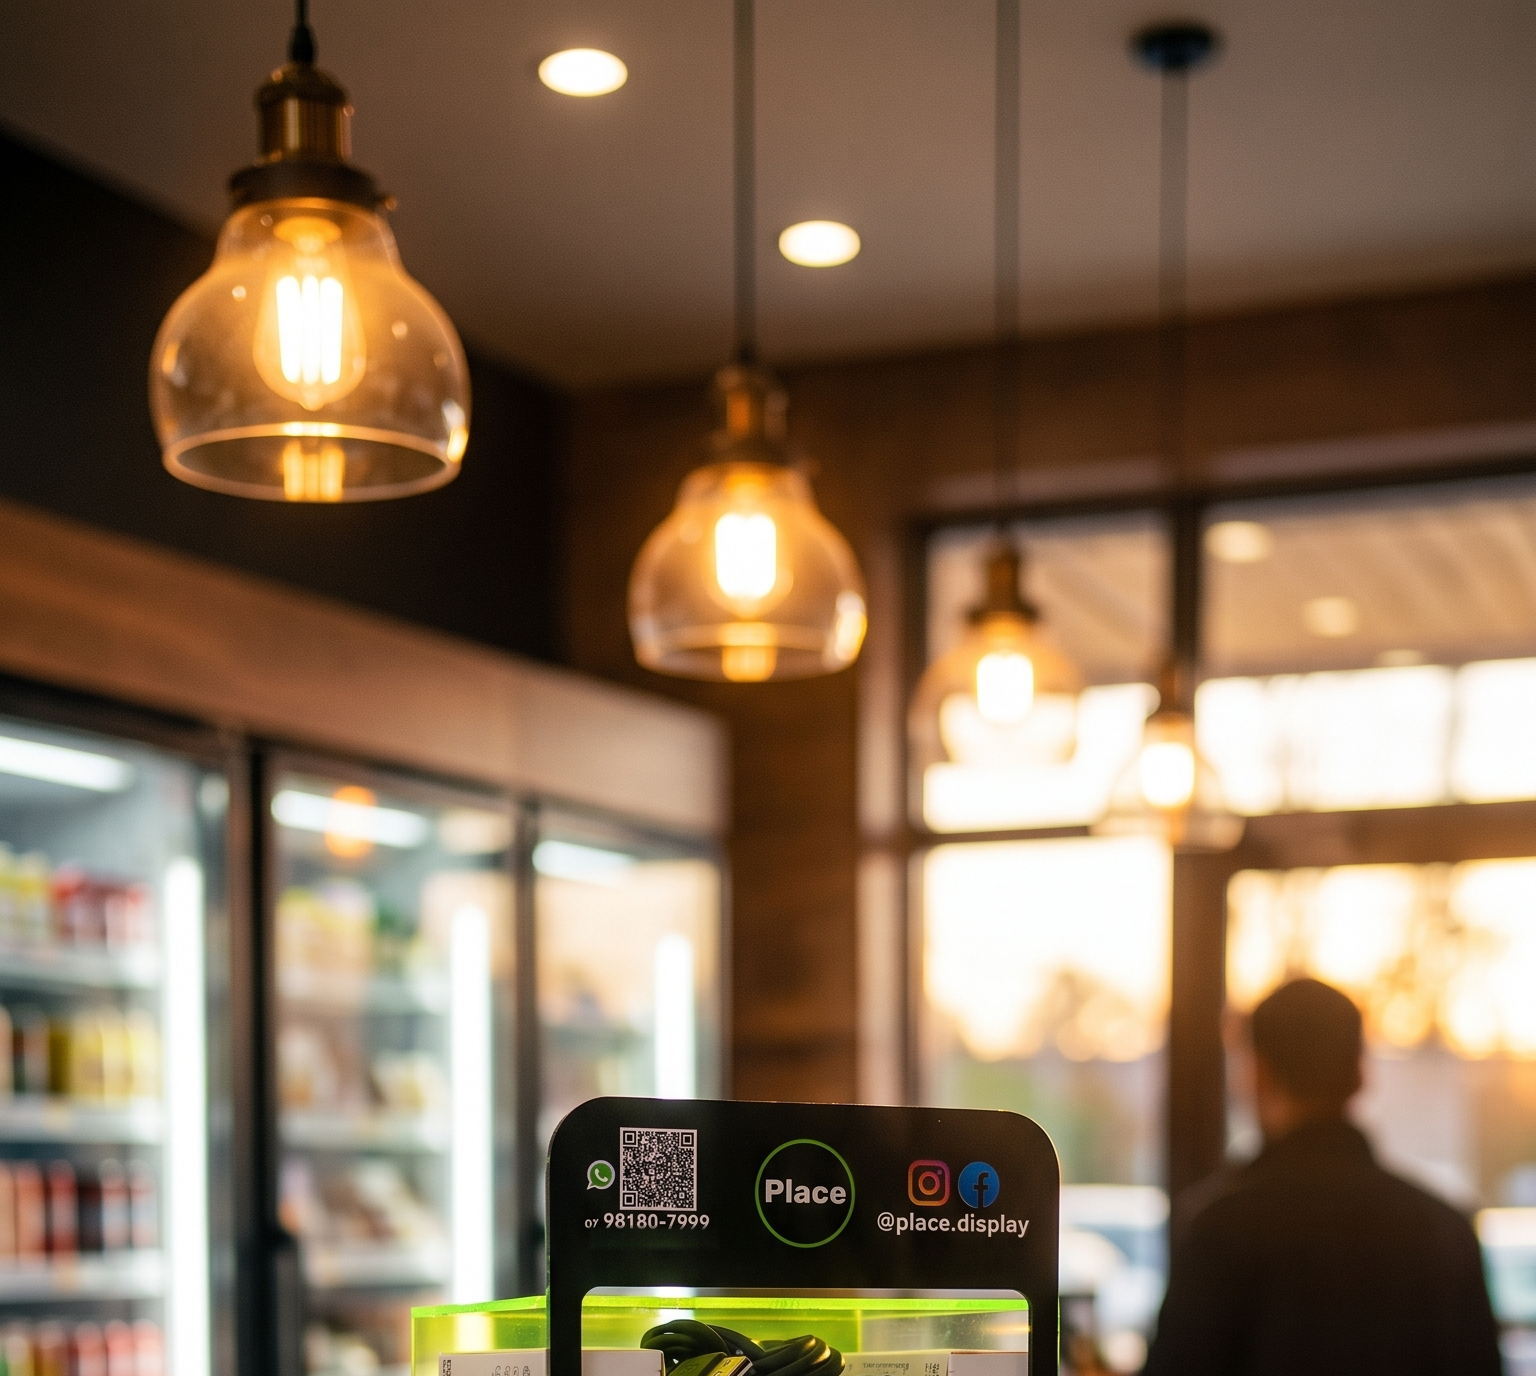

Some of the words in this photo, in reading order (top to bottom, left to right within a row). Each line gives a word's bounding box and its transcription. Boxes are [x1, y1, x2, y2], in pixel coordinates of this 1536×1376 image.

[765, 1178, 847, 1205] Place
[604, 1212, 710, 1229] 98180-7999
[877, 1211, 1030, 1238] @place.display
